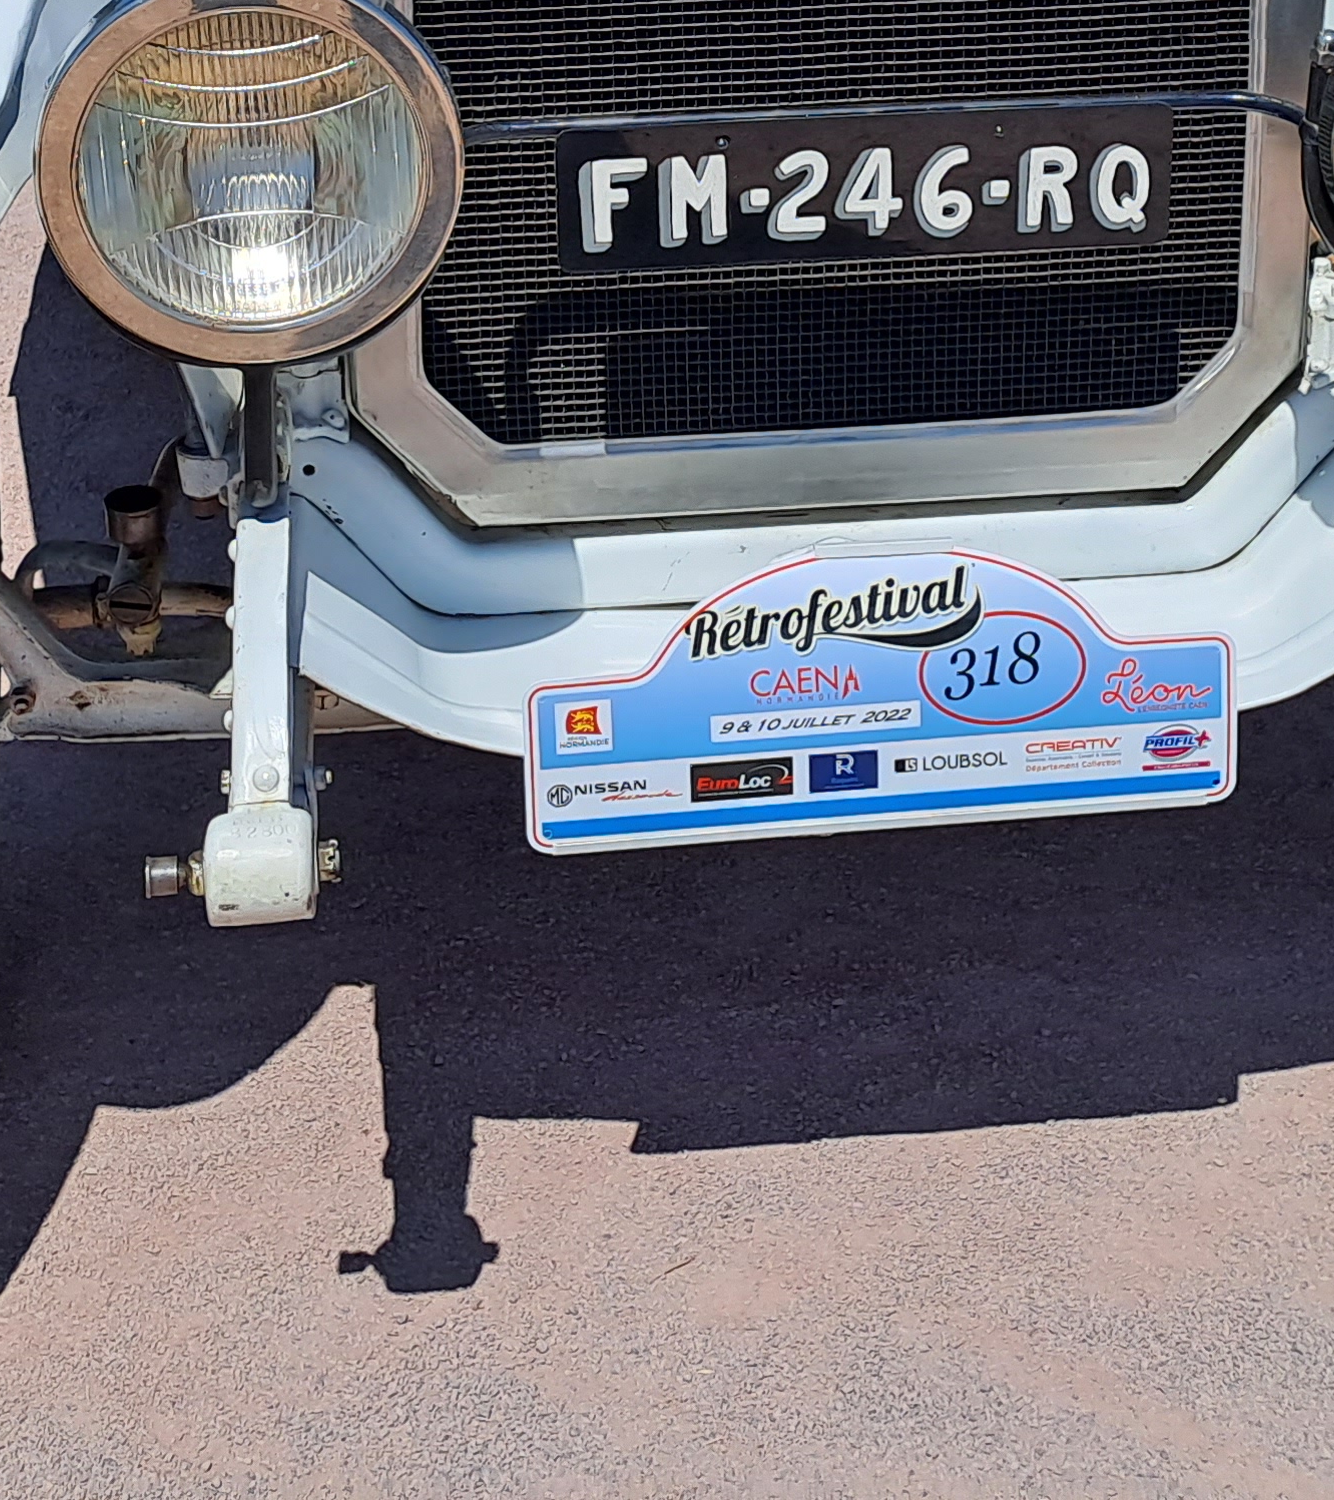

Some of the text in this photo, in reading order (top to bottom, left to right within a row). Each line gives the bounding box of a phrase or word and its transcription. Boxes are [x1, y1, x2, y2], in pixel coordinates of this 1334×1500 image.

[578, 143, 1151, 253] FM-246-RQ
[683, 564, 969, 659] Rétrofestival
[943, 630, 1041, 701] 318
[750, 664, 839, 698] CAEN
[1101, 657, 1212, 713] Léon
[719, 707, 911, 735] 9 & 10 JUILLET 2022
[559, 738, 610, 749] NORMANDIE
[1025, 737, 1118, 754] CREATIV
[922, 750, 1008, 772] LOUBSOL
[574, 779, 647, 797] NISSAN
[696, 773, 772, 792] EuroLoc
[548, 785, 573, 807] MG
